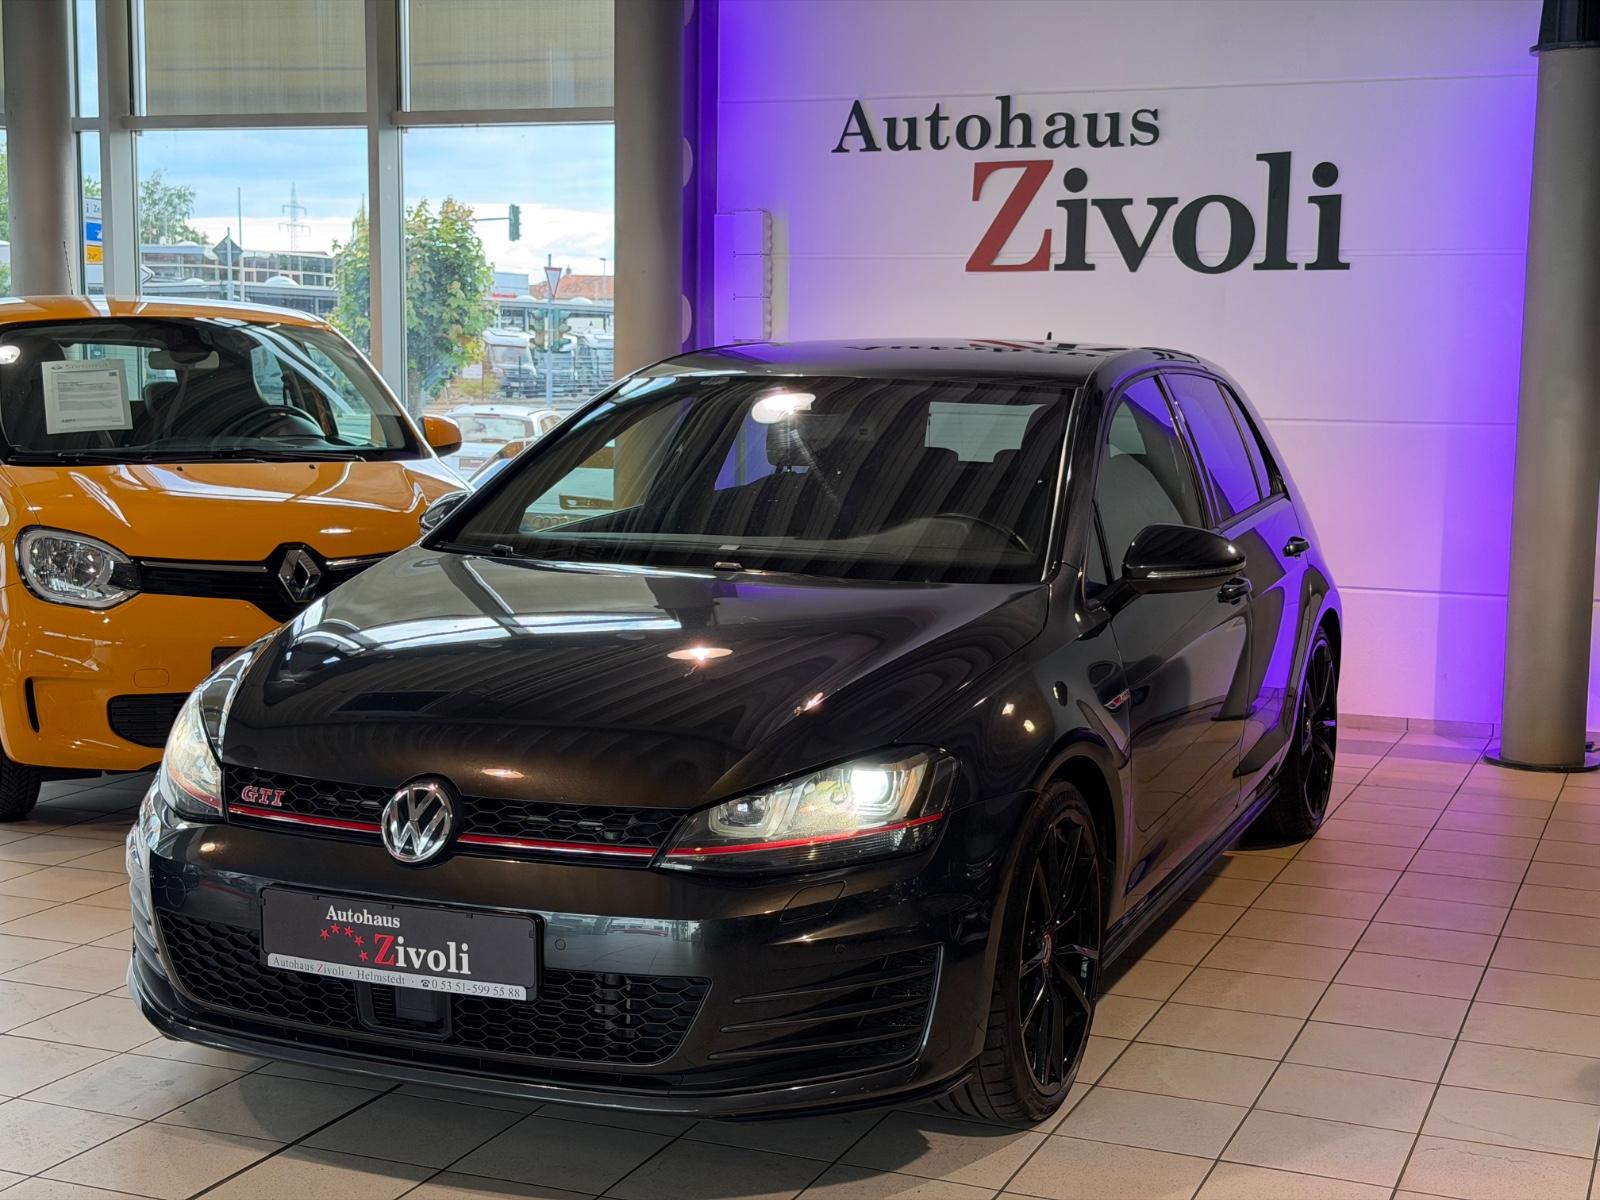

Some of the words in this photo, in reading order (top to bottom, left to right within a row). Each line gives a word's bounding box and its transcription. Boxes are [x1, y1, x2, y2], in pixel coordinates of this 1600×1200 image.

[831, 95, 1161, 154] Autohaus
[965, 151, 1351, 275] Zivoli
[241, 785, 285, 807] GTI
[382, 785, 453, 862] VW
[325, 904, 401, 929] Autohaus
[272, 956, 315, 972] Autohaus
[316, 963, 345, 977] Zivoli
[356, 969, 405, 985] Helmstedt
[373, 933, 472, 975] Zivoli
